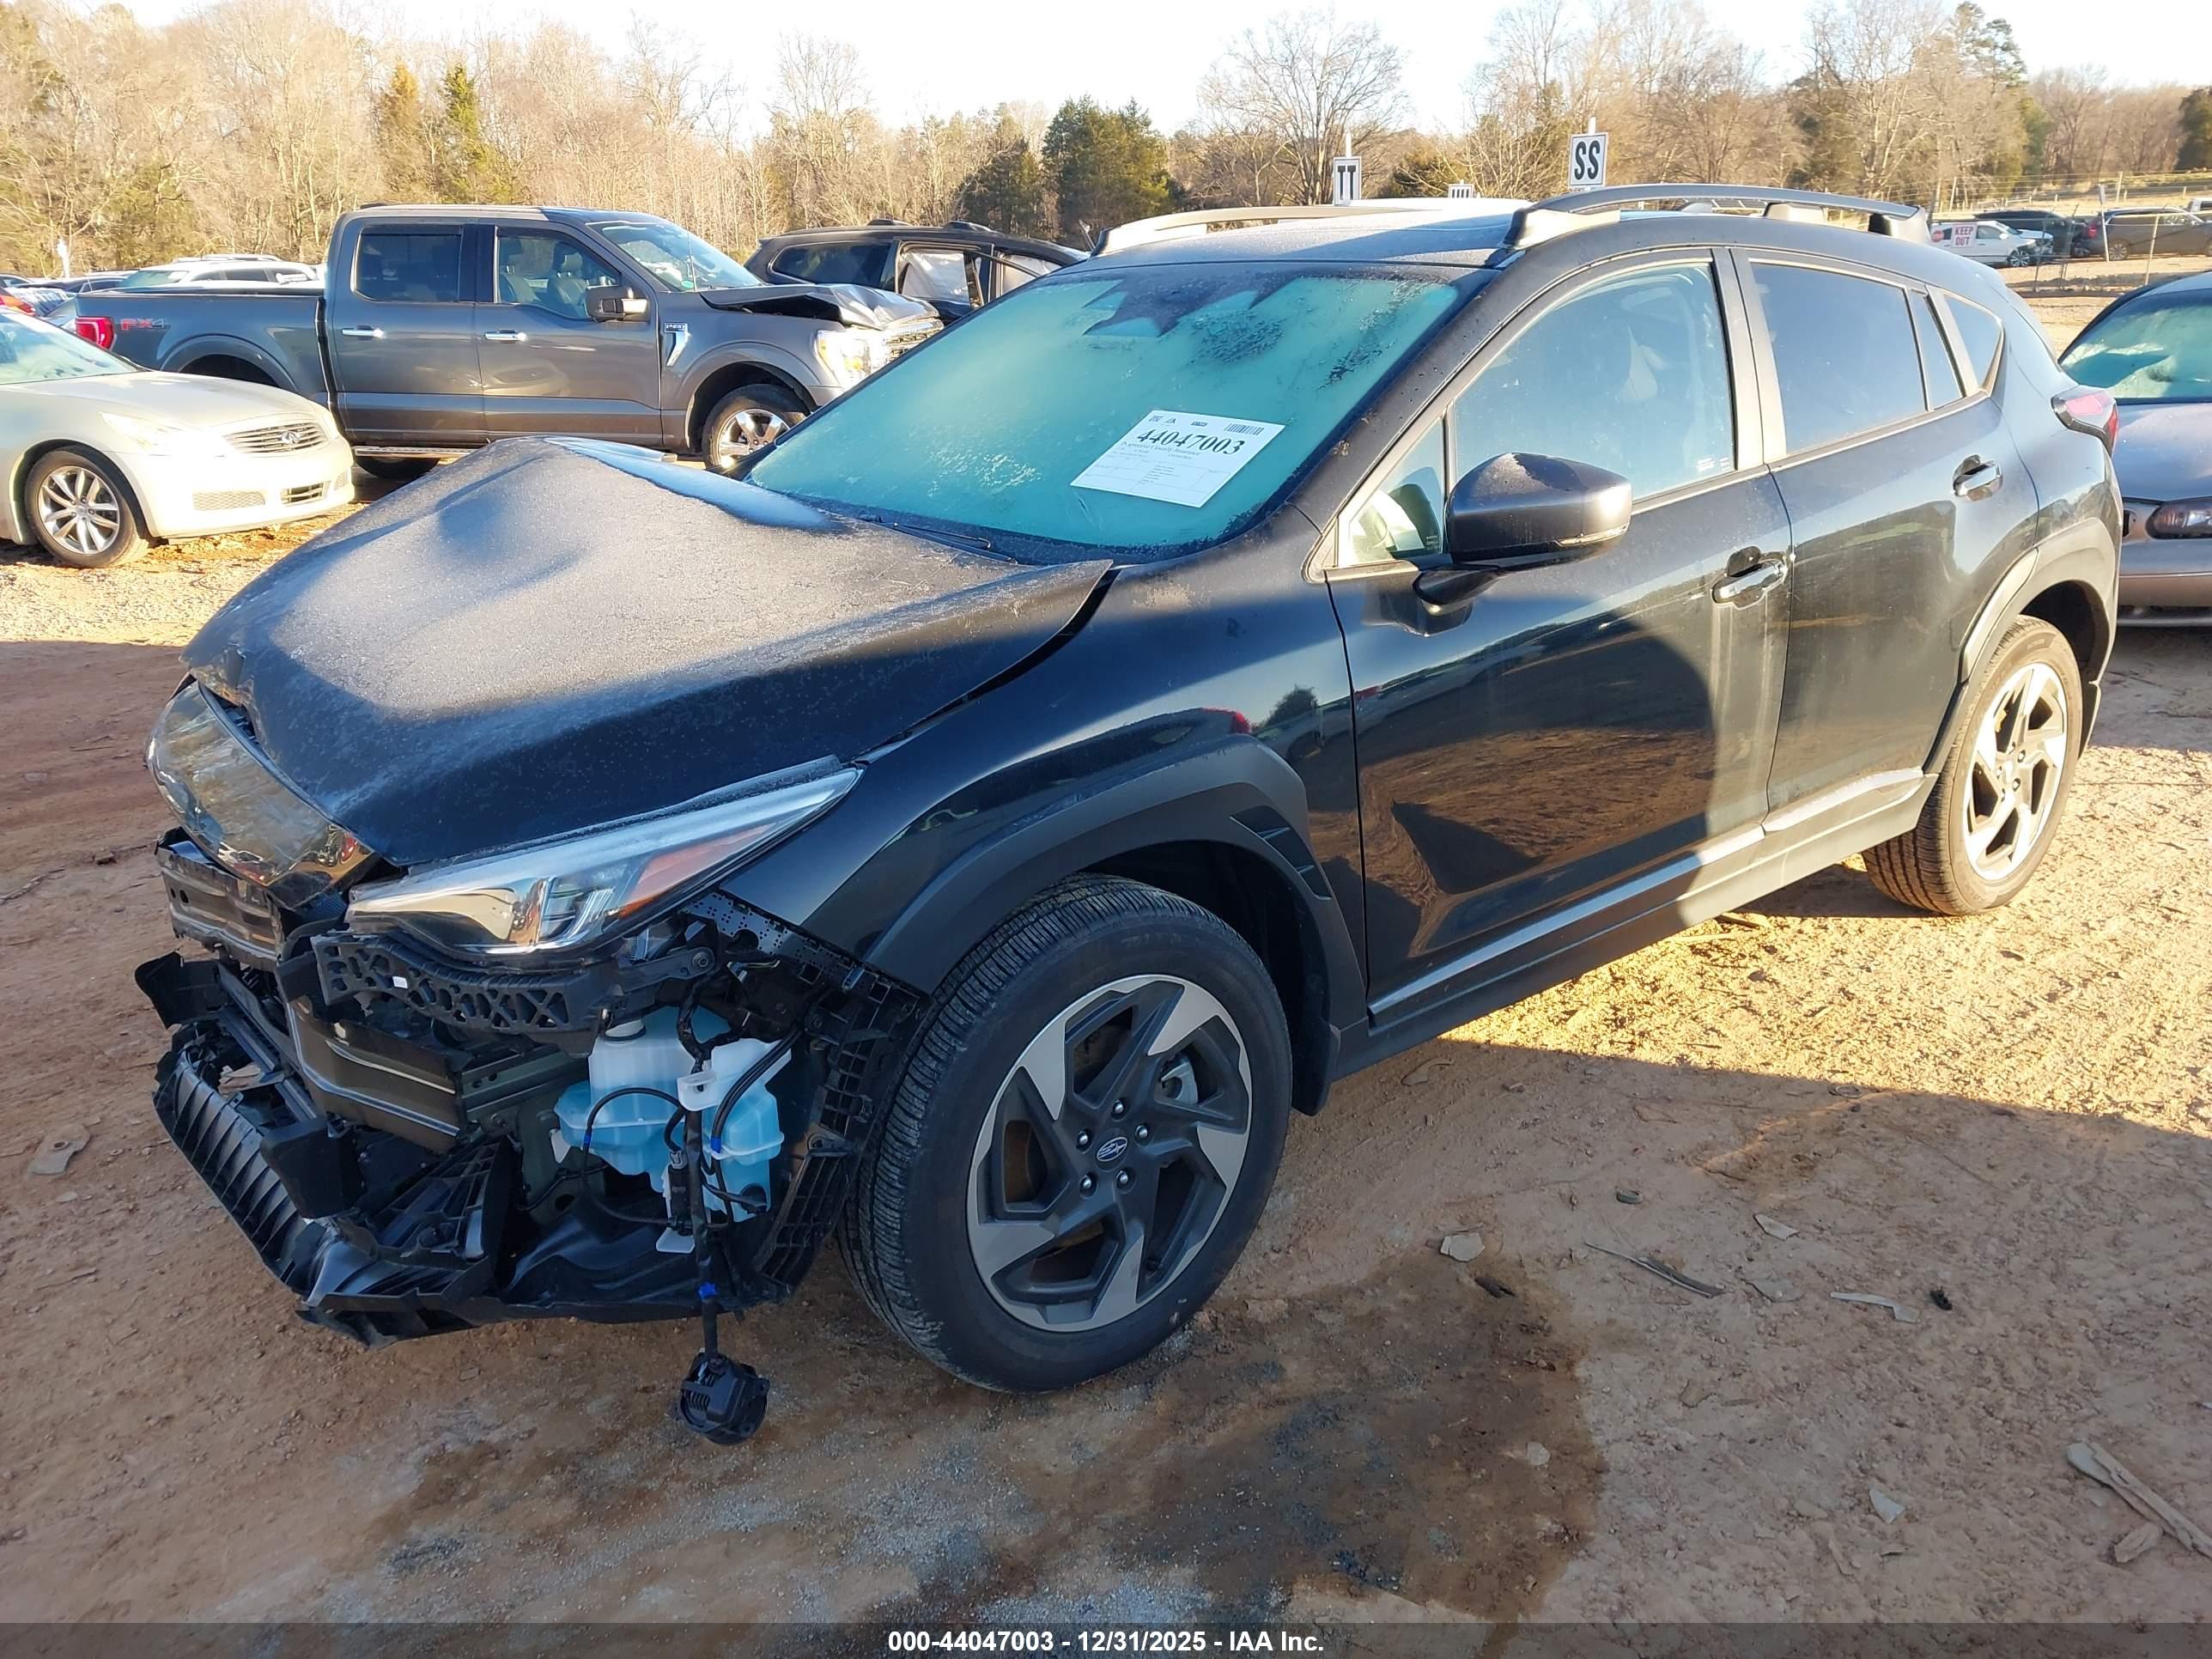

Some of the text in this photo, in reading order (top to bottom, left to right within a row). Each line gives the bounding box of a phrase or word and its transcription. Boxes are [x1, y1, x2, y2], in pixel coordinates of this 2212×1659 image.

[1574, 140, 1601, 180] SS
[1955, 226, 1973, 234] KEEP
[1955, 236, 1970, 246] OUT
[120, 318, 165, 331] FX4
[1136, 428, 1246, 455] 44047003
